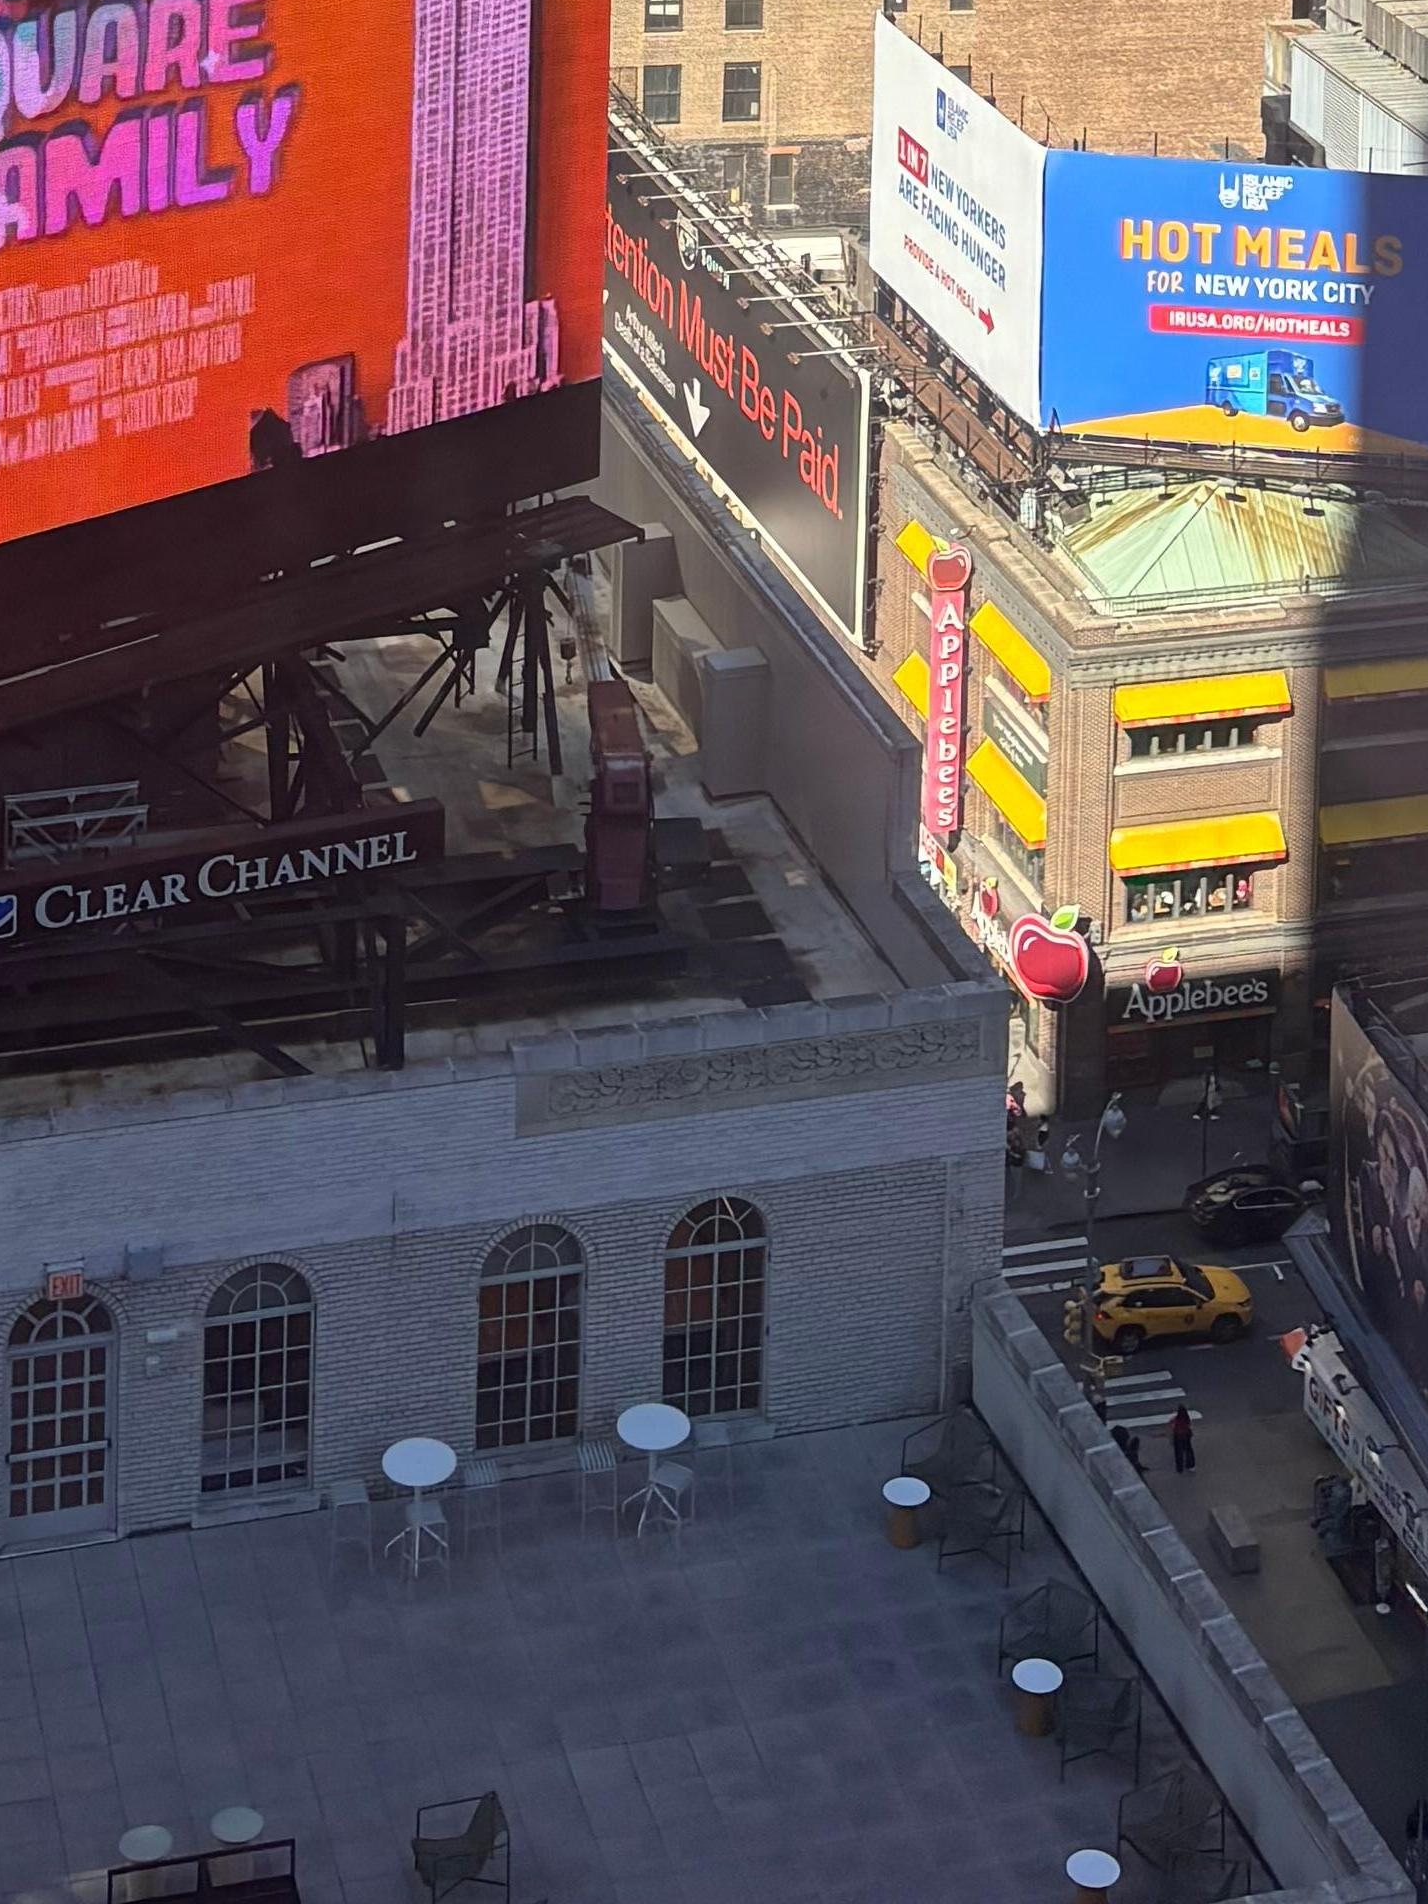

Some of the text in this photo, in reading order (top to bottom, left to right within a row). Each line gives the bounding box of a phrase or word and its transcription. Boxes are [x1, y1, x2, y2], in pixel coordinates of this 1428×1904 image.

[899, 135, 1006, 251] 1 IN 7 NEW YORKERS
[1242, 173, 1293, 190] ISLAMIC
[898, 173, 1006, 292] ARE FACING HUNGER
[1119, 217, 1404, 277] HOT MEALS
[1147, 270, 1375, 305] FOR NEW YORK CITY
[1169, 310, 1350, 337] IRUSA.ORG/HOTMEALS
[604, 203, 844, 521] tention Must Be Paid.
[934, 600, 965, 827] Applebee's
[35, 831, 417, 928] CLEAR CHANNEL
[1122, 978, 1269, 1024] Applebee's
